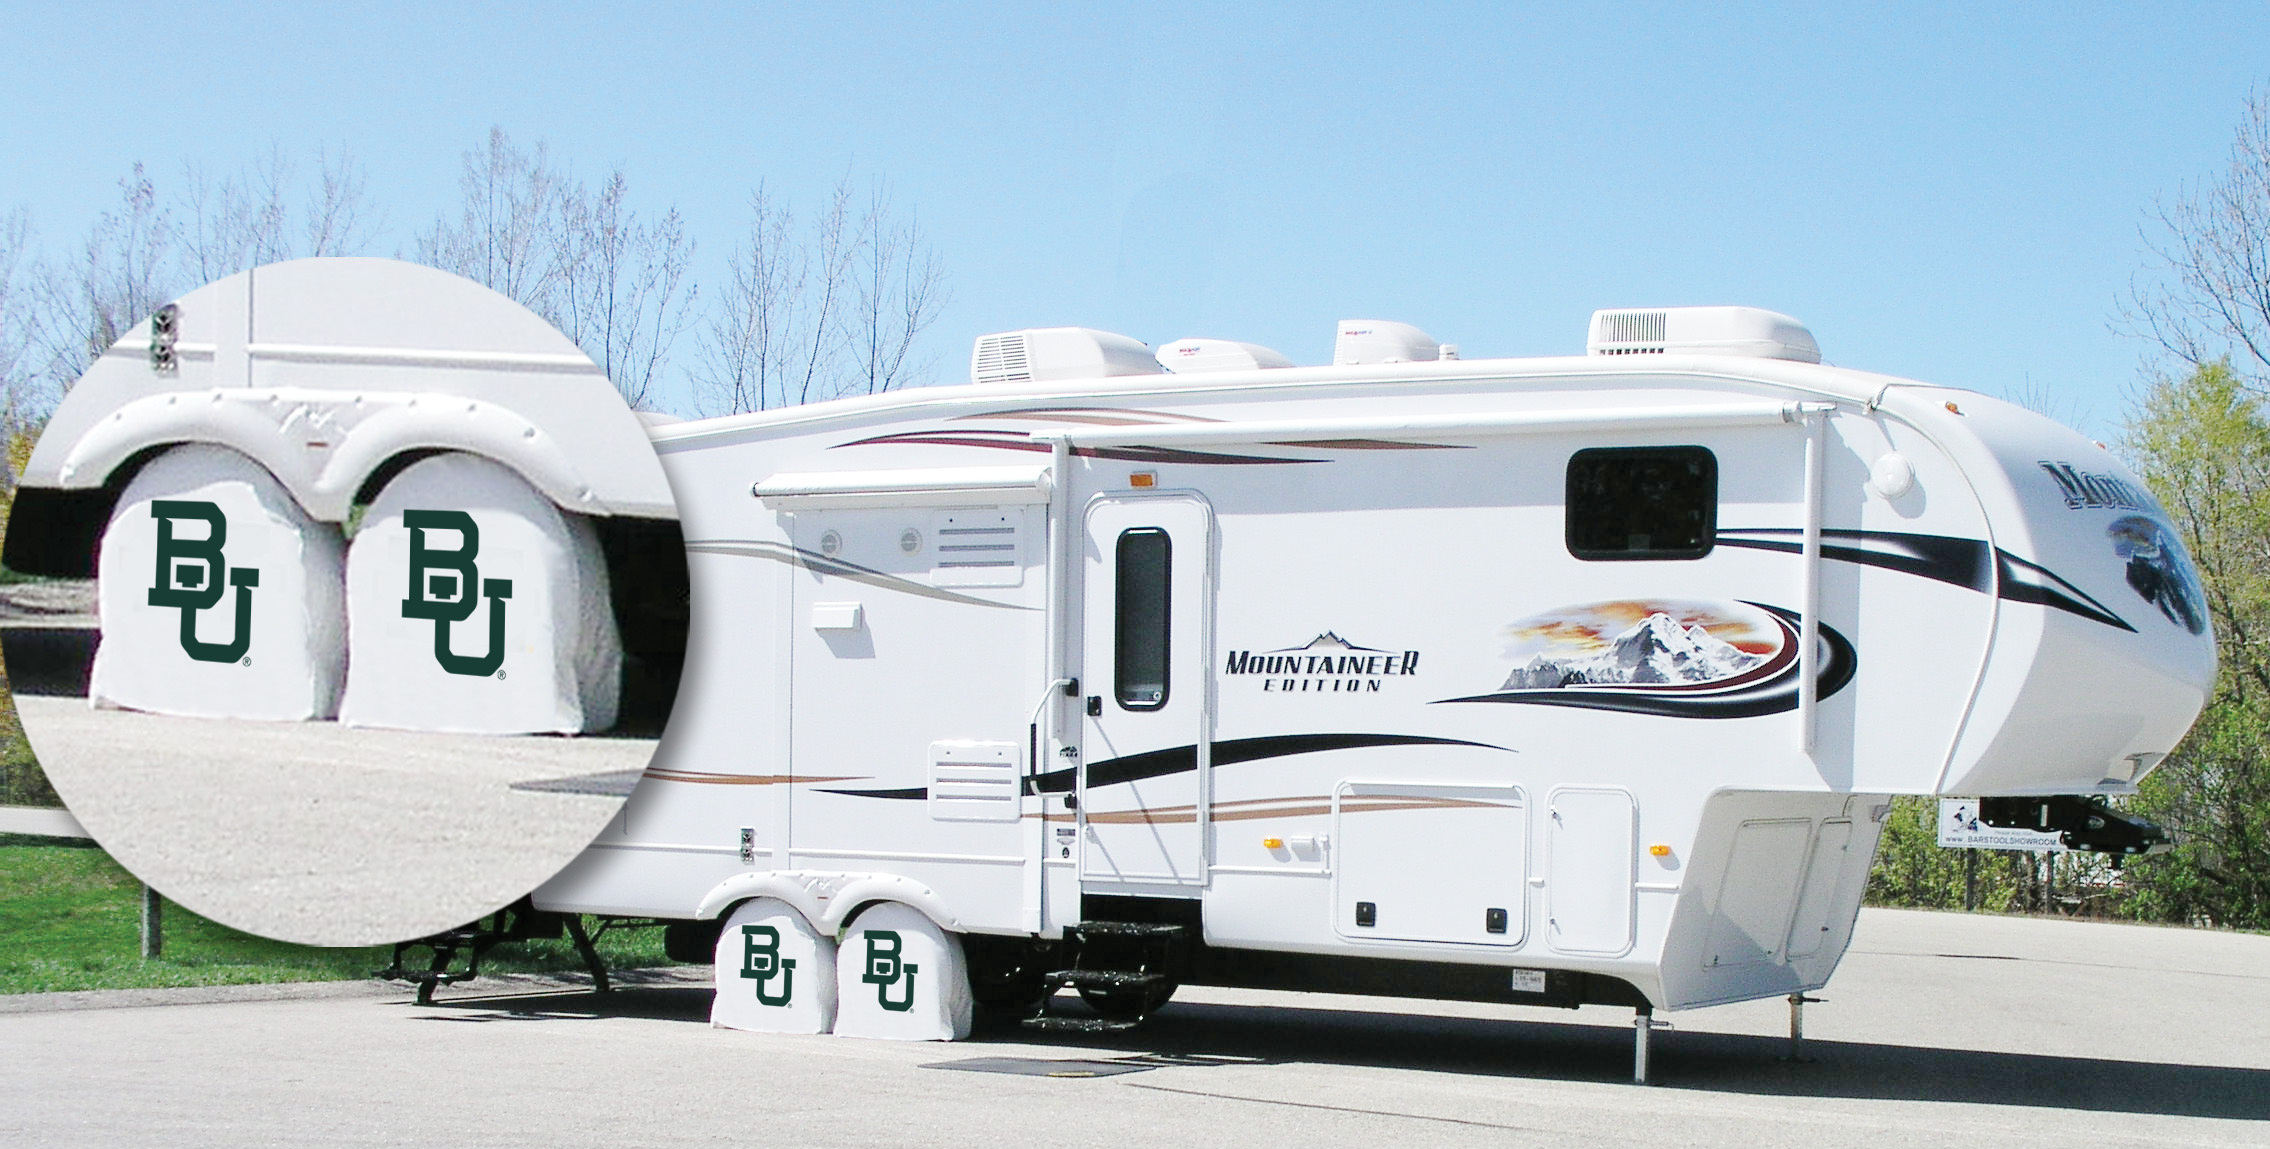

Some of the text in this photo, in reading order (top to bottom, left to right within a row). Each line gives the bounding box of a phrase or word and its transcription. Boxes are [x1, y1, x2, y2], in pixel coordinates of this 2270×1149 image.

[148, 500, 260, 664] BU
[401, 509, 513, 677] BU
[1225, 650, 1420, 676] MOUNTAINEER
[1263, 679, 1382, 693] EDITION
[740, 925, 797, 1007] BU
[862, 930, 919, 1012] BU
